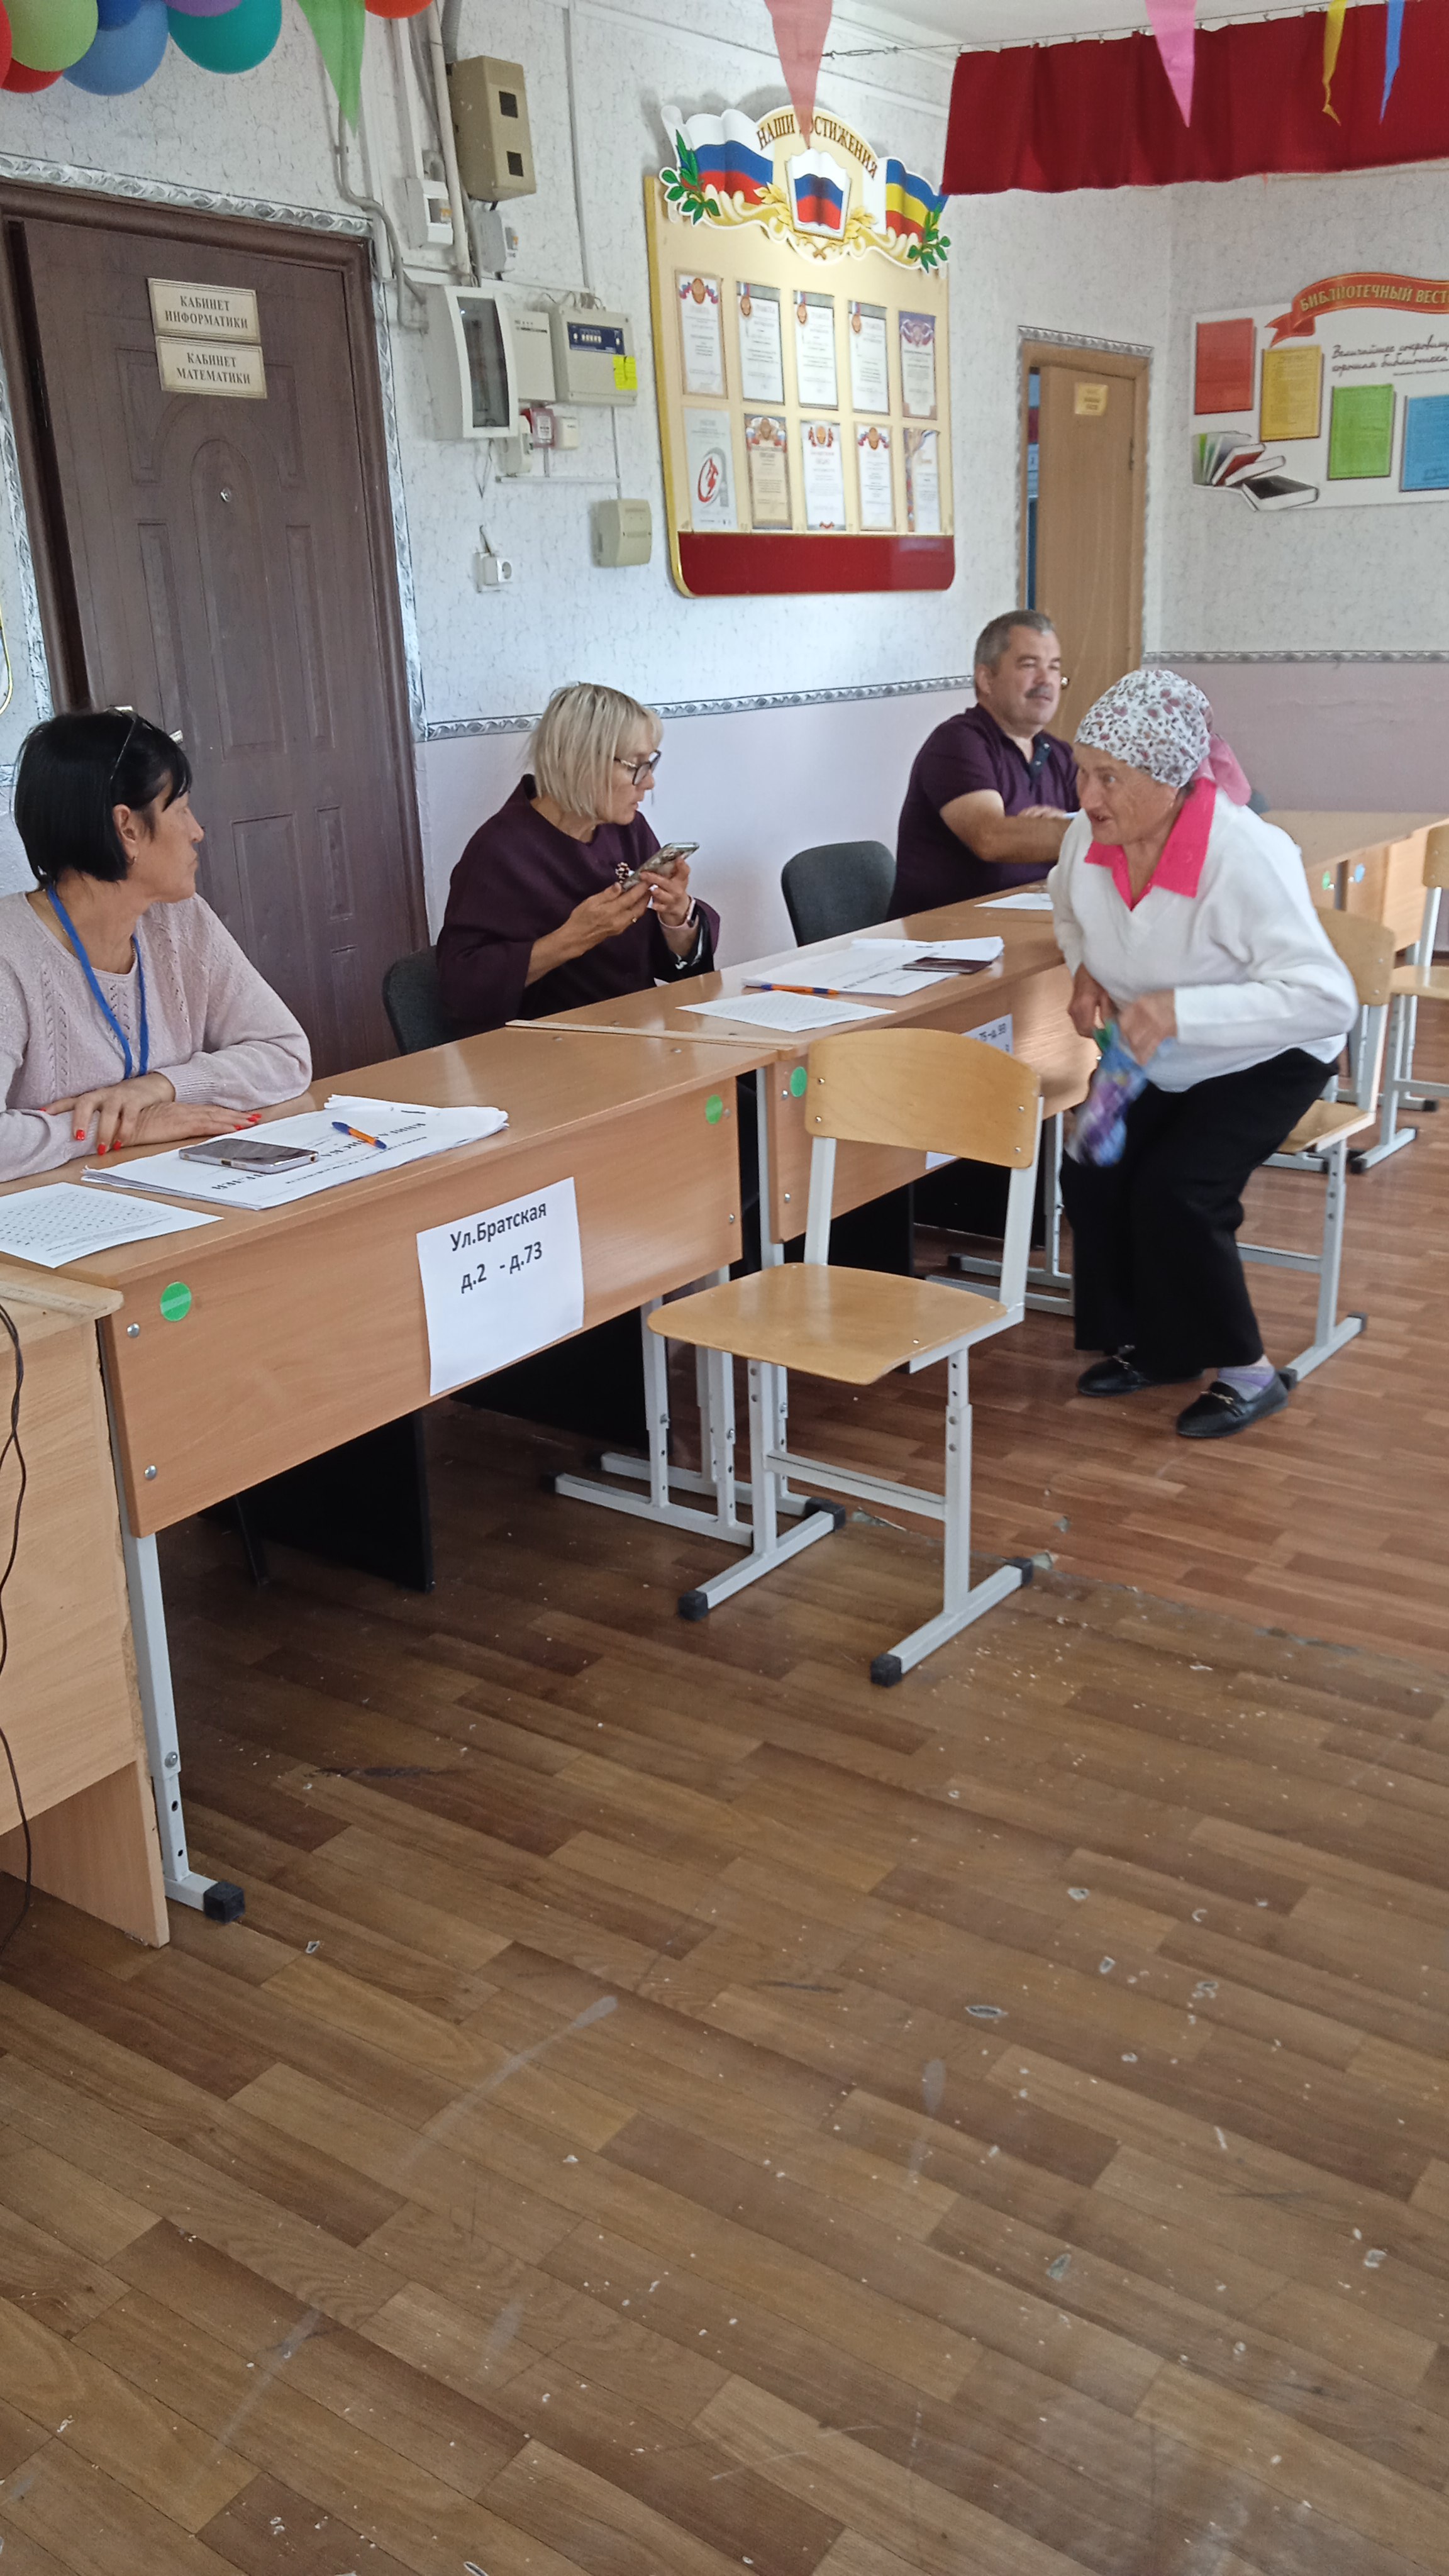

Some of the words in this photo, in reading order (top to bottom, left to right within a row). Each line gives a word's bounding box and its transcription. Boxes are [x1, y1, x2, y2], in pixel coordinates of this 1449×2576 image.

[757, 114, 796, 150] НАШИ
[799, 115, 878, 179] СТИЖЕНИЯ
[180, 296, 230, 311] КАБИНЕТ
[1299, 284, 1414, 312] БИБЛИОТЕЧНЫЙ
[1416, 289, 1449, 304] ВЕСТ
[165, 311, 248, 329] ИНФОРМАТИКИ
[187, 352, 236, 368] КАБИНЕТ
[176, 367, 251, 385] МАТЕМАТИКИ
[450, 1202, 547, 1252] Ул.Братская
[460, 1263, 487, 1294] д.2
[509, 1241, 543, 1274] д.73
